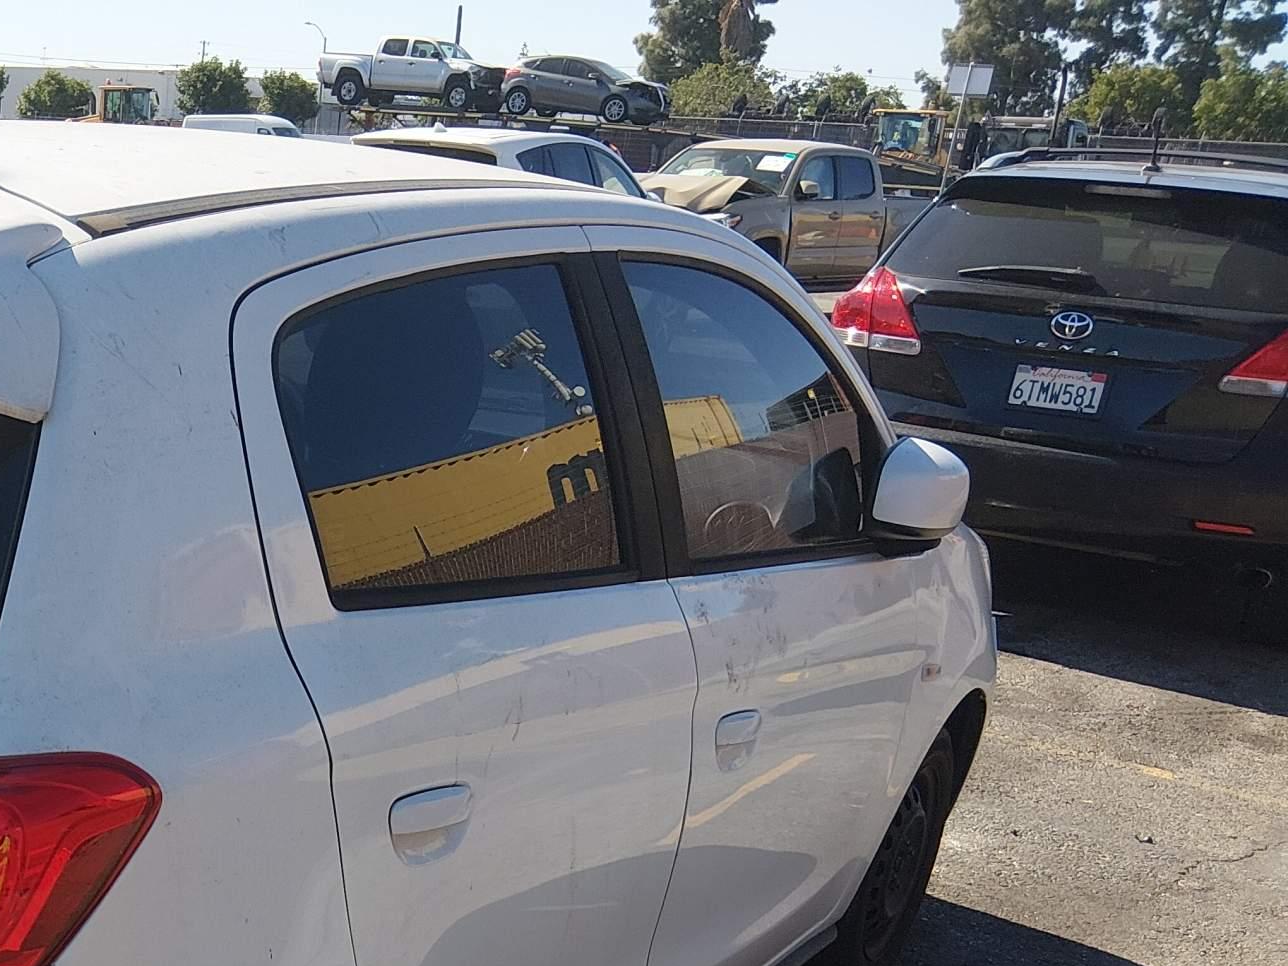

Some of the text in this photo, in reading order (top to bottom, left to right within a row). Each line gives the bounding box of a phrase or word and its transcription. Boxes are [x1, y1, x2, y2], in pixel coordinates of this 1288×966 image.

[1015, 338, 1119, 356] VENZA
[1032, 366, 1086, 382] California
[1012, 379, 1097, 410] 6TMW581
